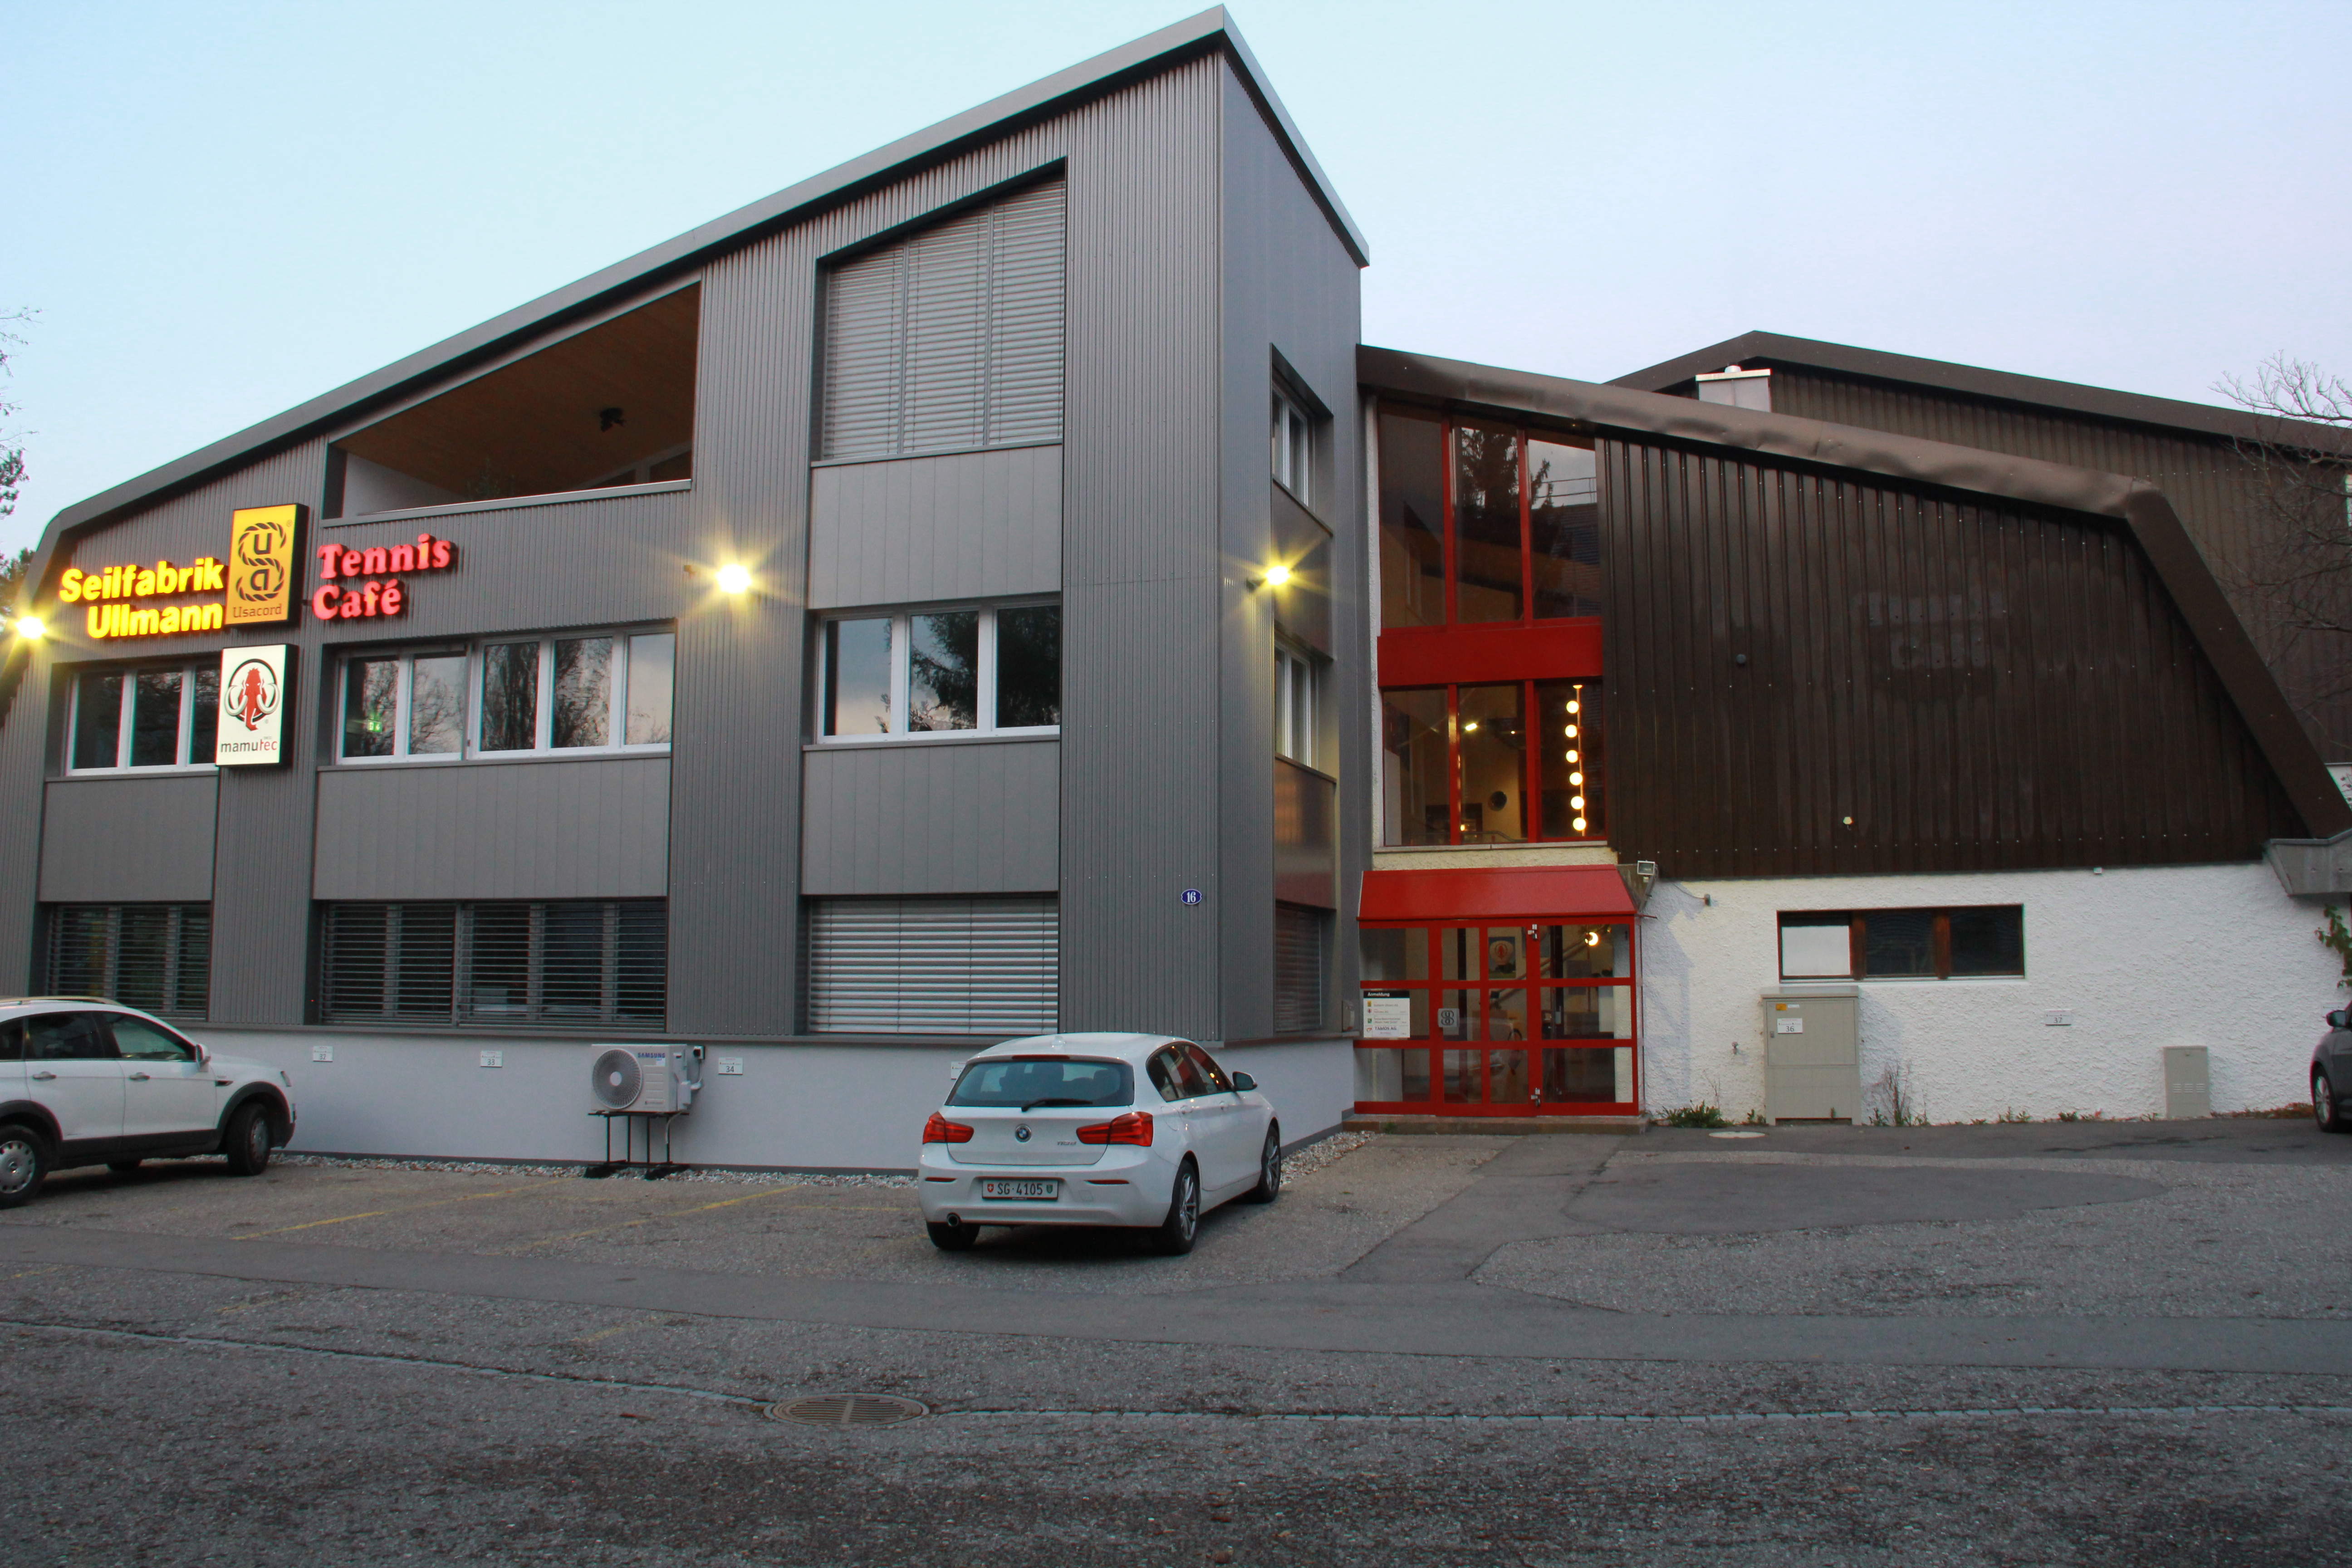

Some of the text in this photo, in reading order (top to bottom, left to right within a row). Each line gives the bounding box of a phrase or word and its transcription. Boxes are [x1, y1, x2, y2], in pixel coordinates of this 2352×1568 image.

[317, 533, 451, 579] Tennis
[59, 557, 225, 603] Seilfabrik
[233, 603, 282, 617] Usacord
[312, 578, 401, 620] Café
[87, 603, 224, 639] Ullmann
[221, 739, 278, 753] mamutec
[1187, 892, 1196, 903] 16
